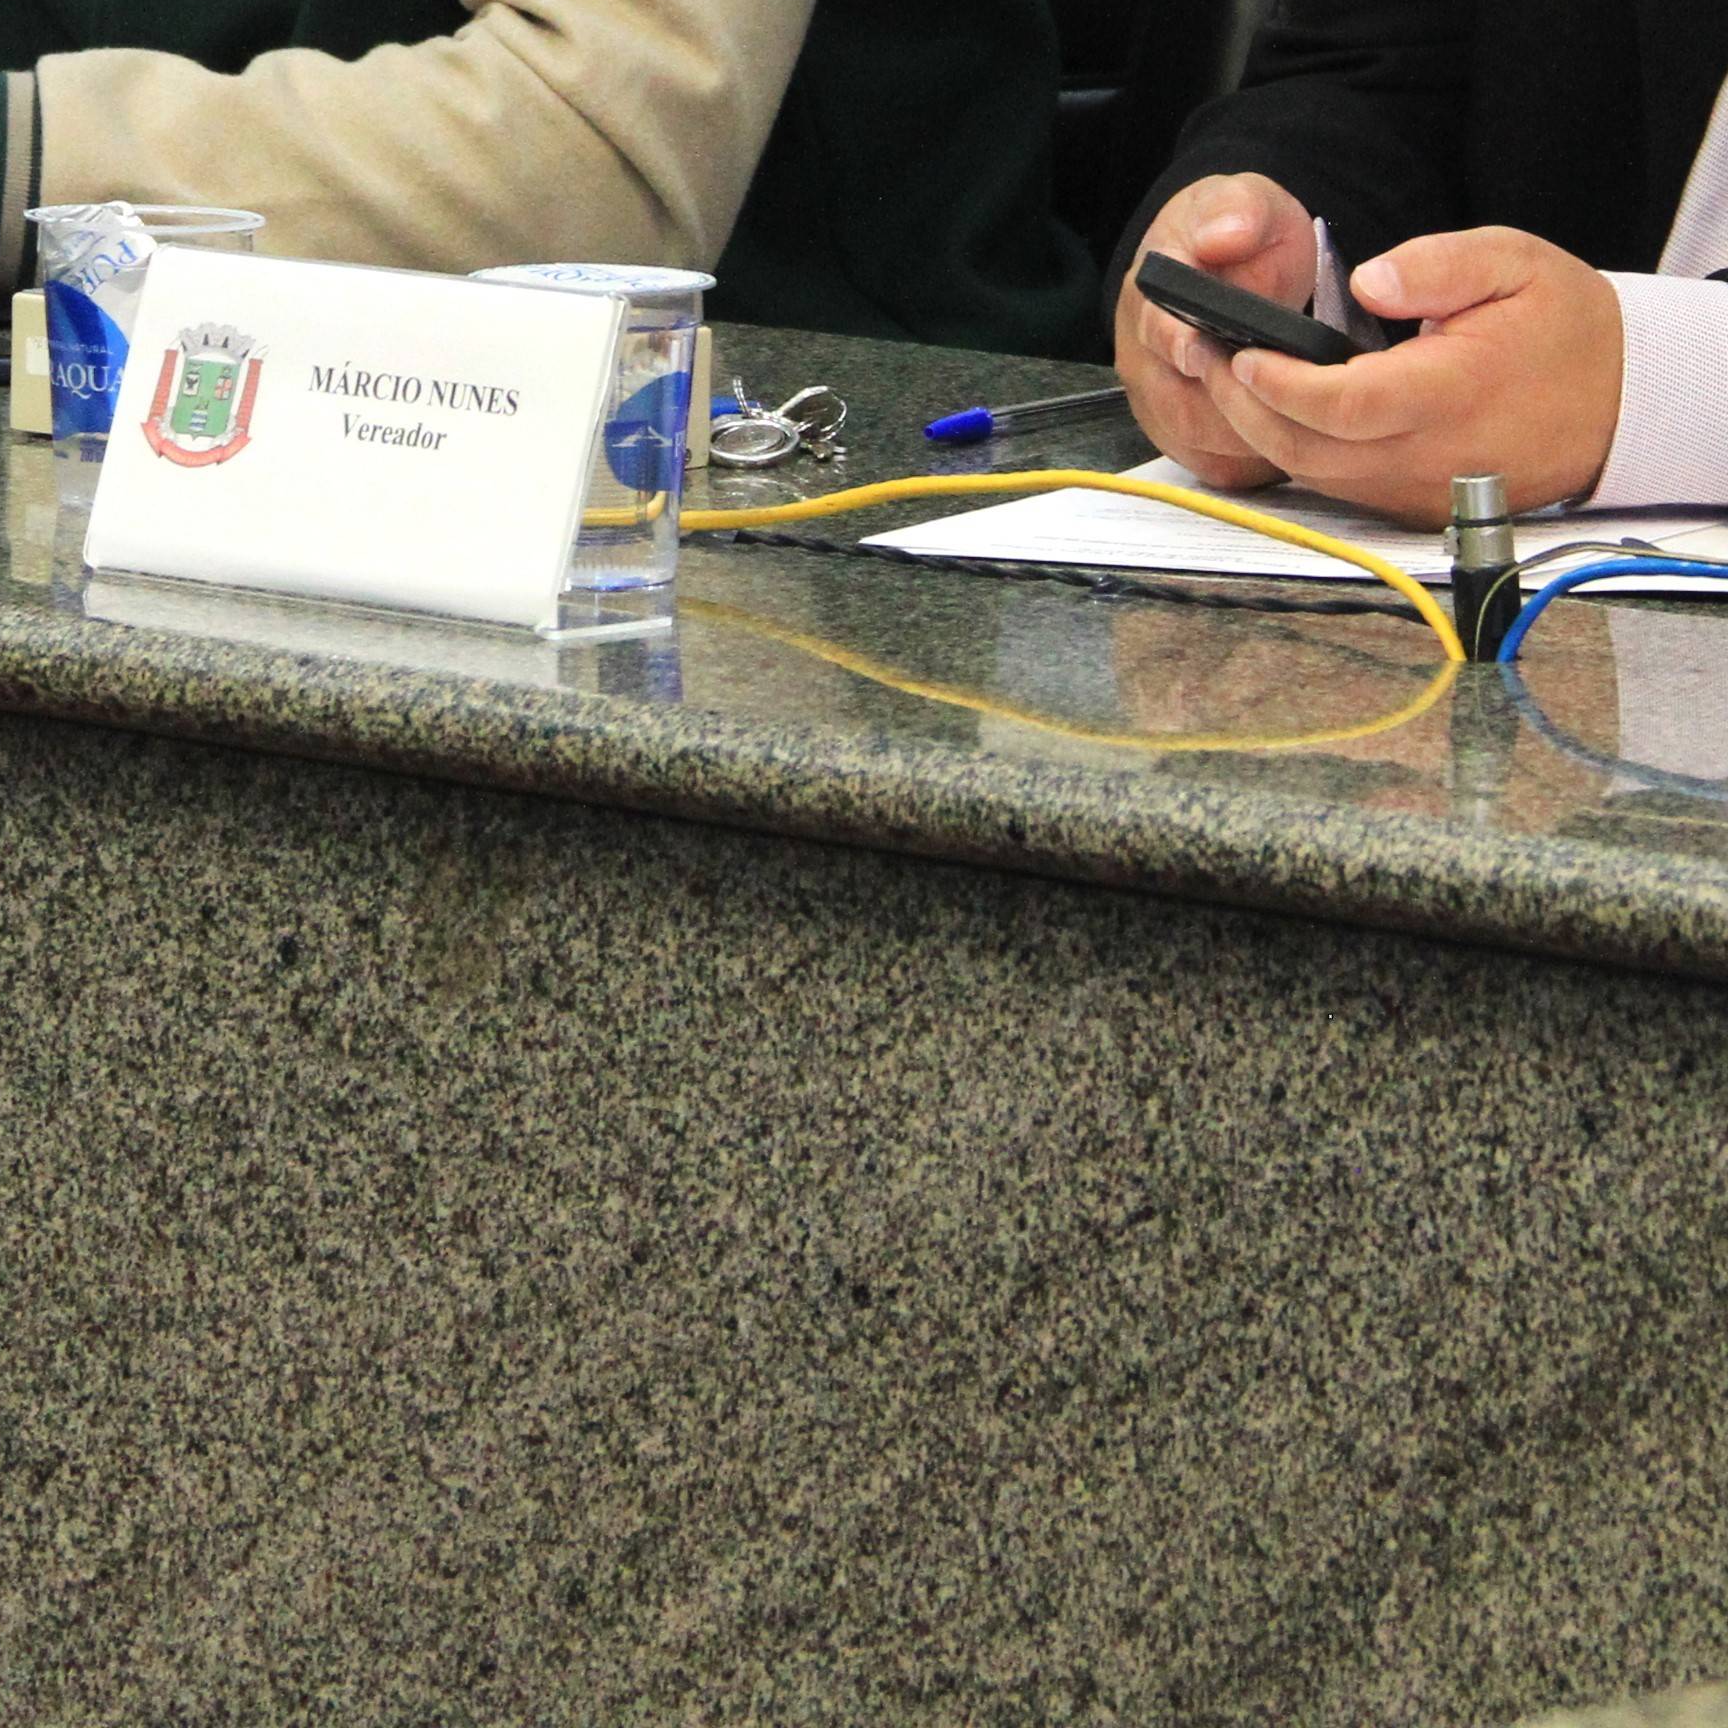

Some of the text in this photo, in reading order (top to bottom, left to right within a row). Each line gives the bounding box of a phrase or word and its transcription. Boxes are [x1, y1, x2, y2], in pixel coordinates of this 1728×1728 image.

[307, 360, 521, 418] MÁRCIO NUNES
[341, 412, 448, 451] Vereador
